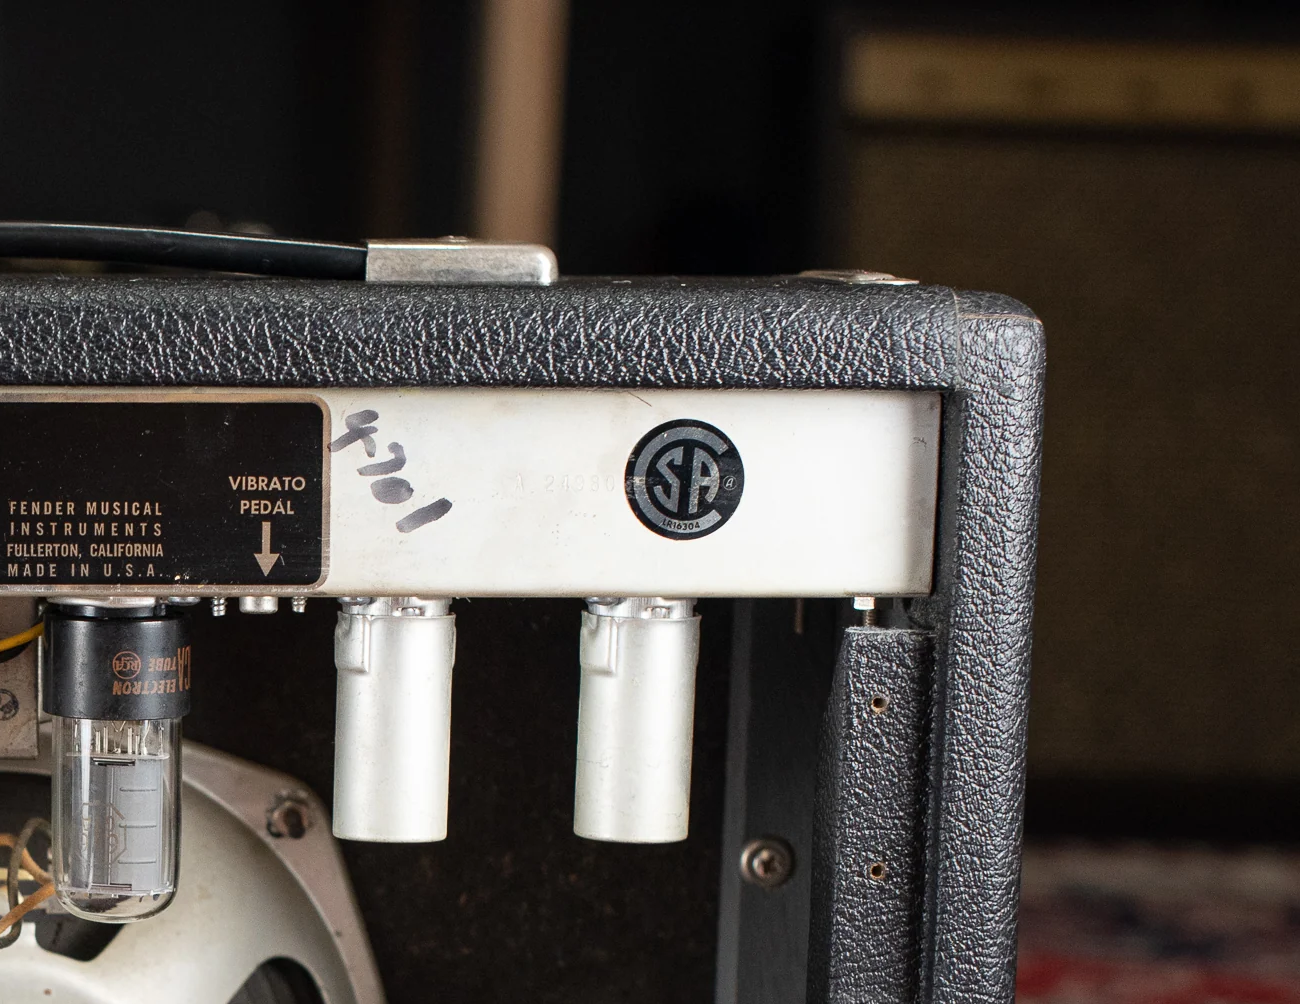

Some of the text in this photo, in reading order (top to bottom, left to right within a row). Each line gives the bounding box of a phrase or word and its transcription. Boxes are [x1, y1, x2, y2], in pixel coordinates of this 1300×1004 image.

[327, 409, 453, 533] 4701
[228, 476, 306, 491] VIBRATO
[8, 501, 163, 516] FENDER MUSICAL
[240, 500, 295, 515] PEDAL
[9, 522, 163, 537] INSTRUMENTS
[662, 518, 700, 531] LR16304
[6, 543, 165, 559] FULLERTON, CALIFORNIA
[7, 563, 164, 577] MADE IN U.S.A.
[148, 656, 176, 672] TUBE
[112, 679, 176, 695] ELECTRON
